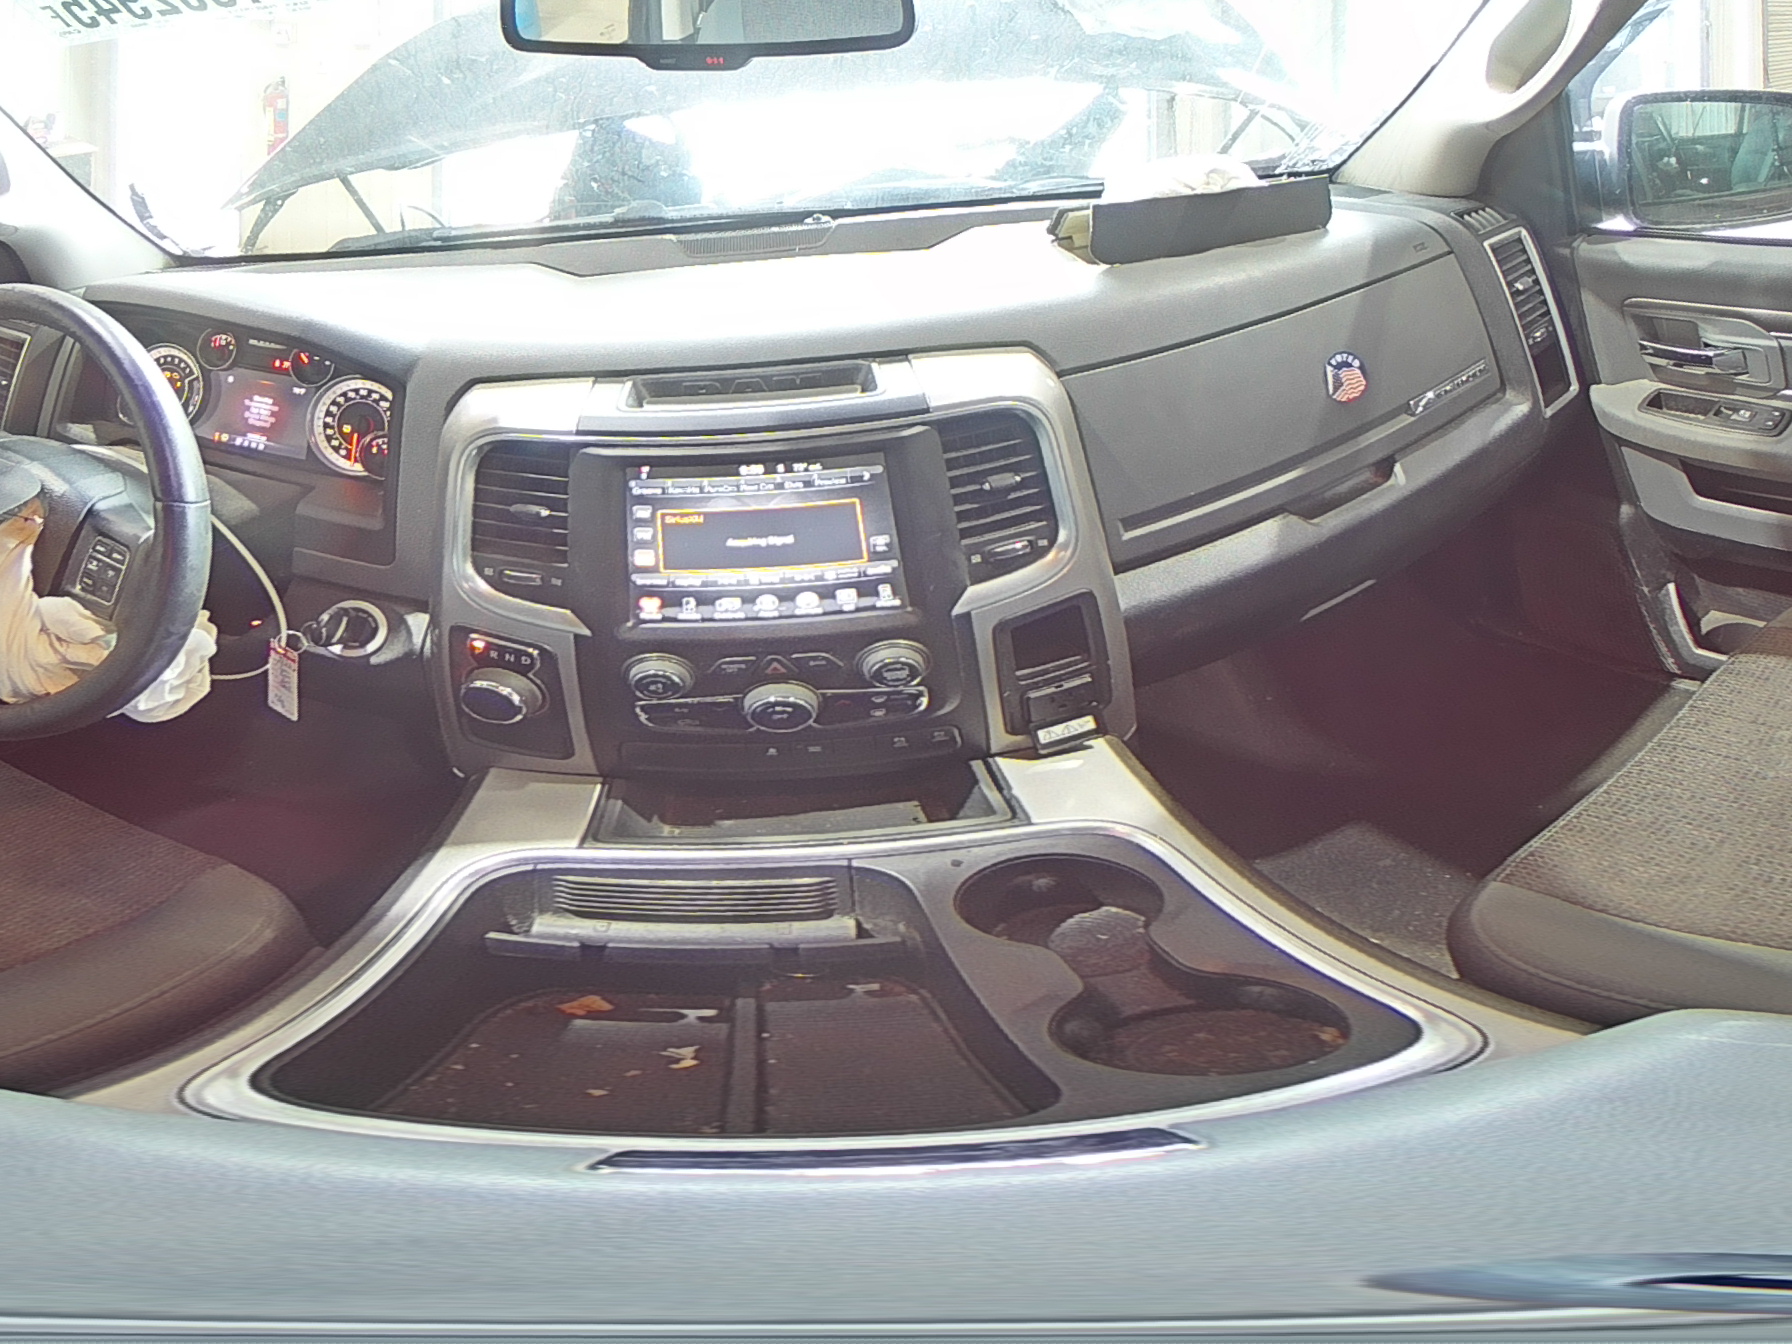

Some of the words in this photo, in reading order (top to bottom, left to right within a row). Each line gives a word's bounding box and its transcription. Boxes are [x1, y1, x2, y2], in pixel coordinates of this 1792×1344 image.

[1329, 353, 1361, 368] VOTED
[489, 650, 499, 660] R
[504, 652, 515, 662] N
[521, 655, 532, 665] D
